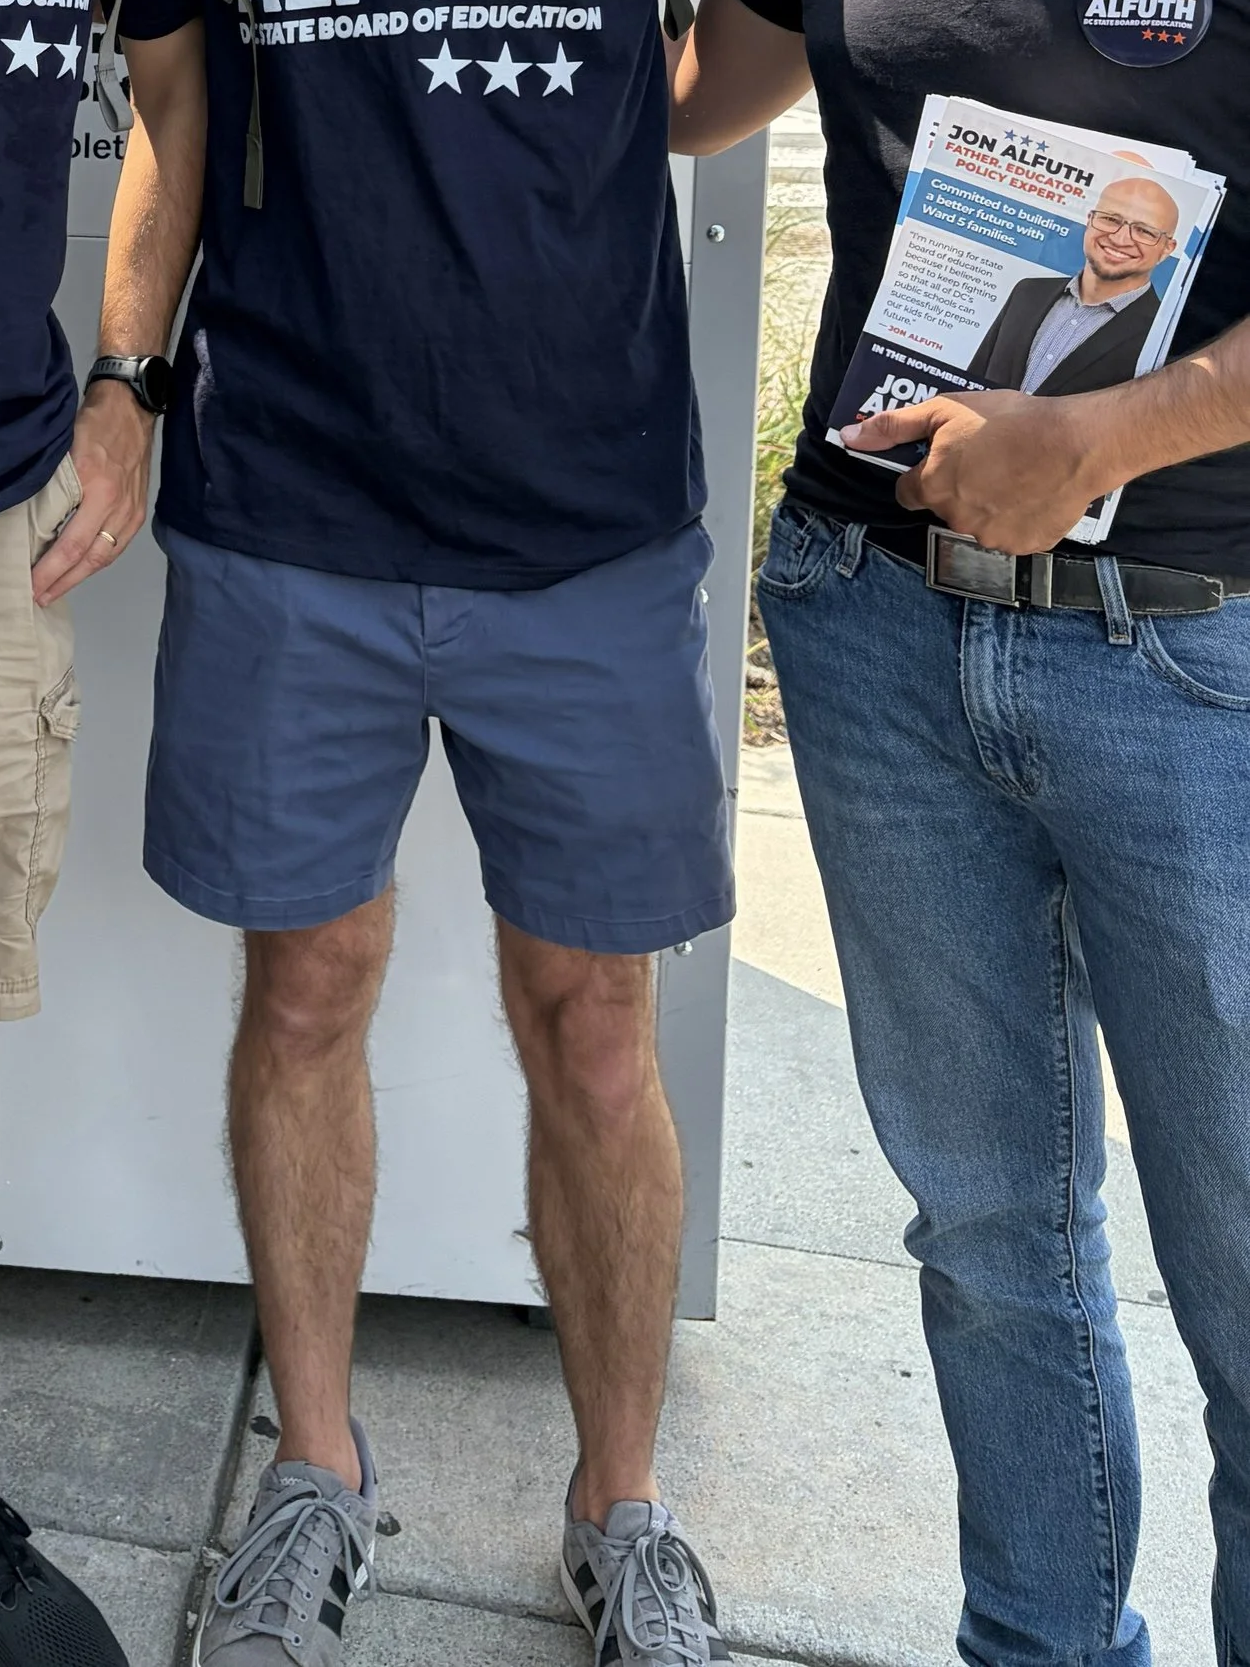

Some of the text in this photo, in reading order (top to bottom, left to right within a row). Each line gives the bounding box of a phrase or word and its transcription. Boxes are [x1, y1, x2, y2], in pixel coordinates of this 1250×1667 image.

[259, 18, 316, 45] STATE
[318, 11, 408, 40] BOARD
[412, 6, 449, 32] OF
[452, 6, 603, 31] EDUCATION
[1151, 20, 1193, 29] EDUCATION
[945, 141, 1086, 199] FATHER. EDUCATOR.
[947, 124, 997, 153] JON
[999, 144, 1095, 187] ALFUTH
[955, 158, 1066, 204] POLICY EXPERT.
[922, 203, 1018, 246] Ward 5 families.
[925, 192, 1045, 241] a better future with
[931, 178, 1070, 237] Committed to building
[904, 250, 943, 270] because
[948, 266, 982, 284] believe
[982, 280, 997, 290] we
[908, 241, 993, 278] board of education
[928, 238, 965, 258] running
[965, 251, 979, 262] for
[979, 258, 1004, 271] state
[893, 280, 976, 315] public schools can
[897, 270, 974, 304] so that all of DC's
[901, 261, 998, 303] need to keep fighting
[886, 299, 954, 330] our kids for the
[890, 289, 981, 329] successfully prepare
[887, 325, 943, 351] JON ALFUTH
[871, 343, 885, 355] IN
[885, 348, 907, 364] THE
[905, 357, 968, 387] NOVEMBER
